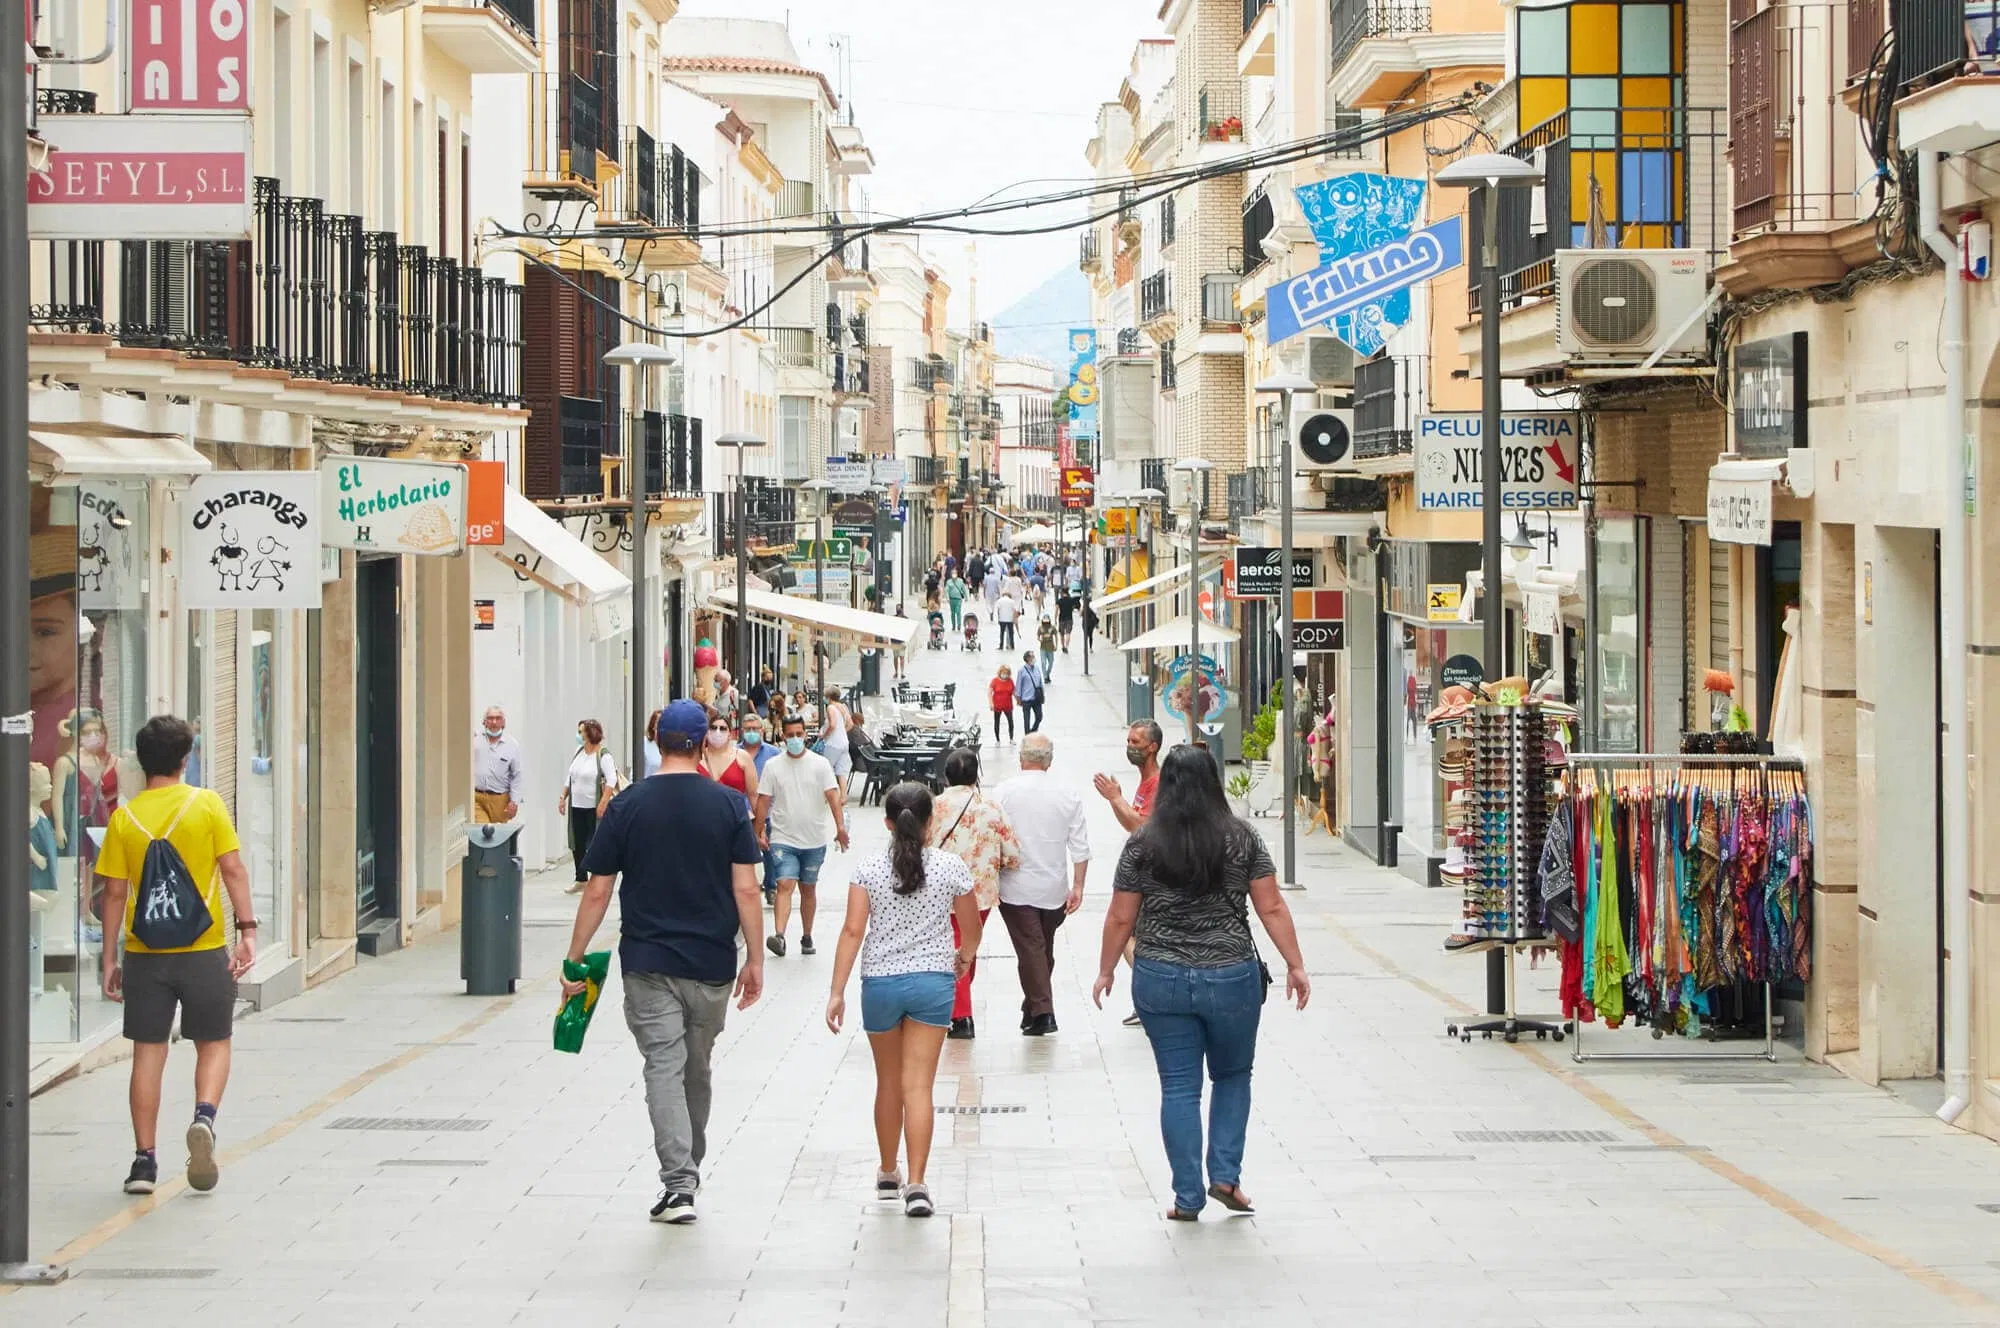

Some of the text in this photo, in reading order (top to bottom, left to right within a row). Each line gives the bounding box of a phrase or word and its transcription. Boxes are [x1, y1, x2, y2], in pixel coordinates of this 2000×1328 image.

[1422, 418, 1573, 437] PELUUERIA
[338, 463, 362, 492] El
[1452, 446, 1545, 484] NIVES
[193, 489, 309, 530] Charanga
[338, 477, 451, 522] Herbolario
[1422, 491, 1575, 508] HAIRDESSER
